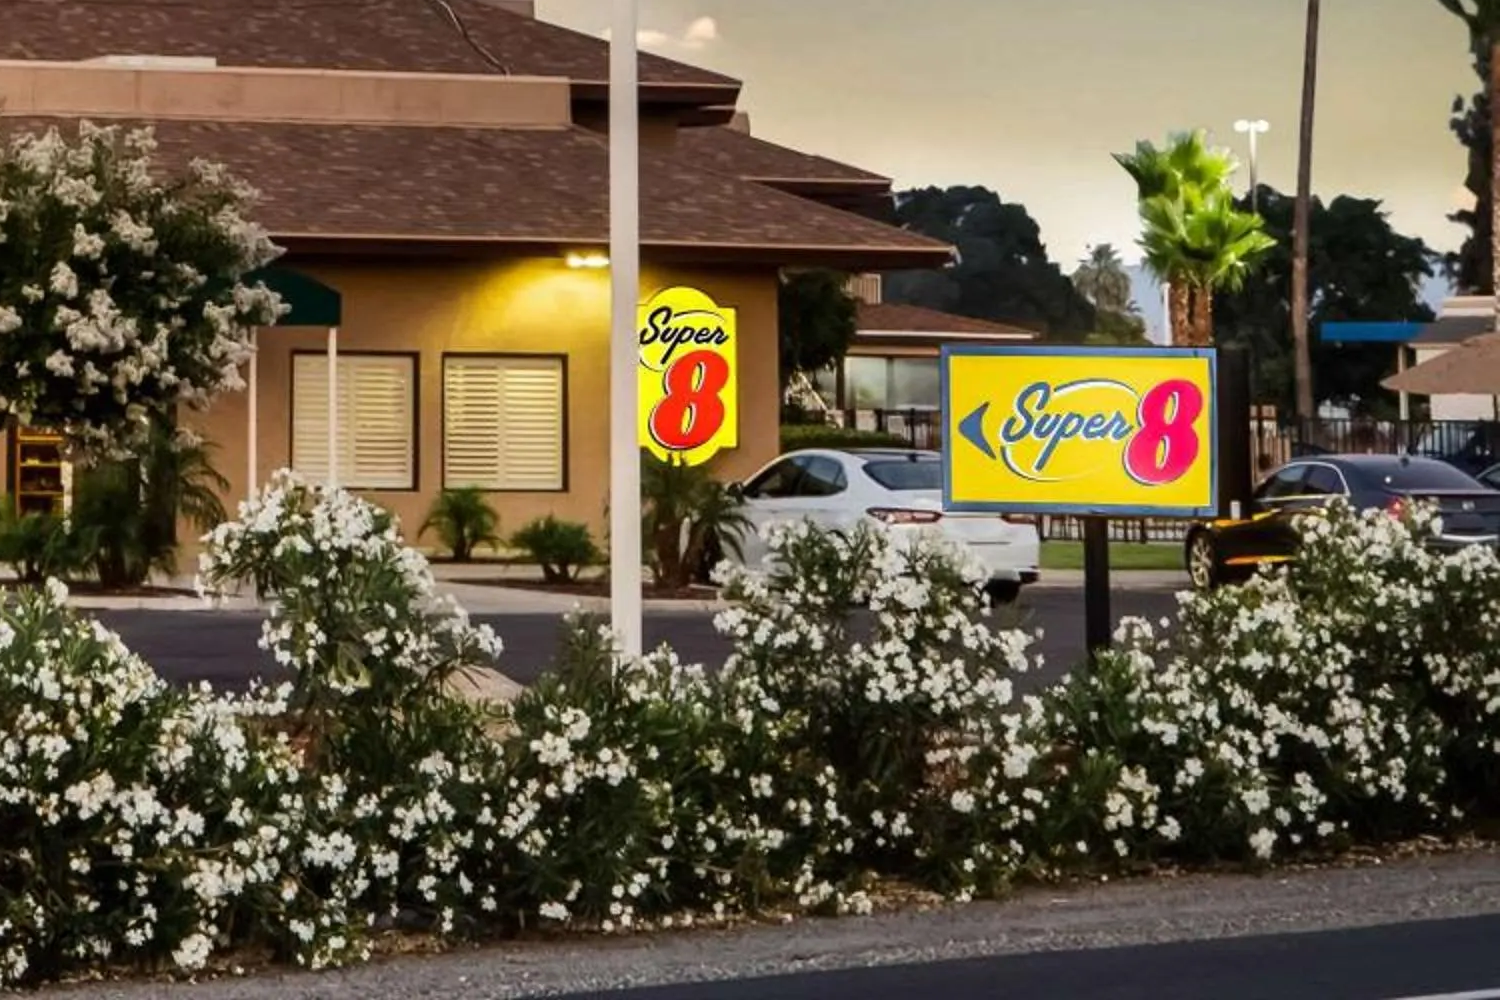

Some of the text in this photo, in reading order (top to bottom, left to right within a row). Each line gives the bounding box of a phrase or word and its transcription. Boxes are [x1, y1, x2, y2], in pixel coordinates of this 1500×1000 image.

[639, 306, 729, 365] Super
[647, 350, 730, 450] 8
[1000, 378, 1204, 486] Super 8
